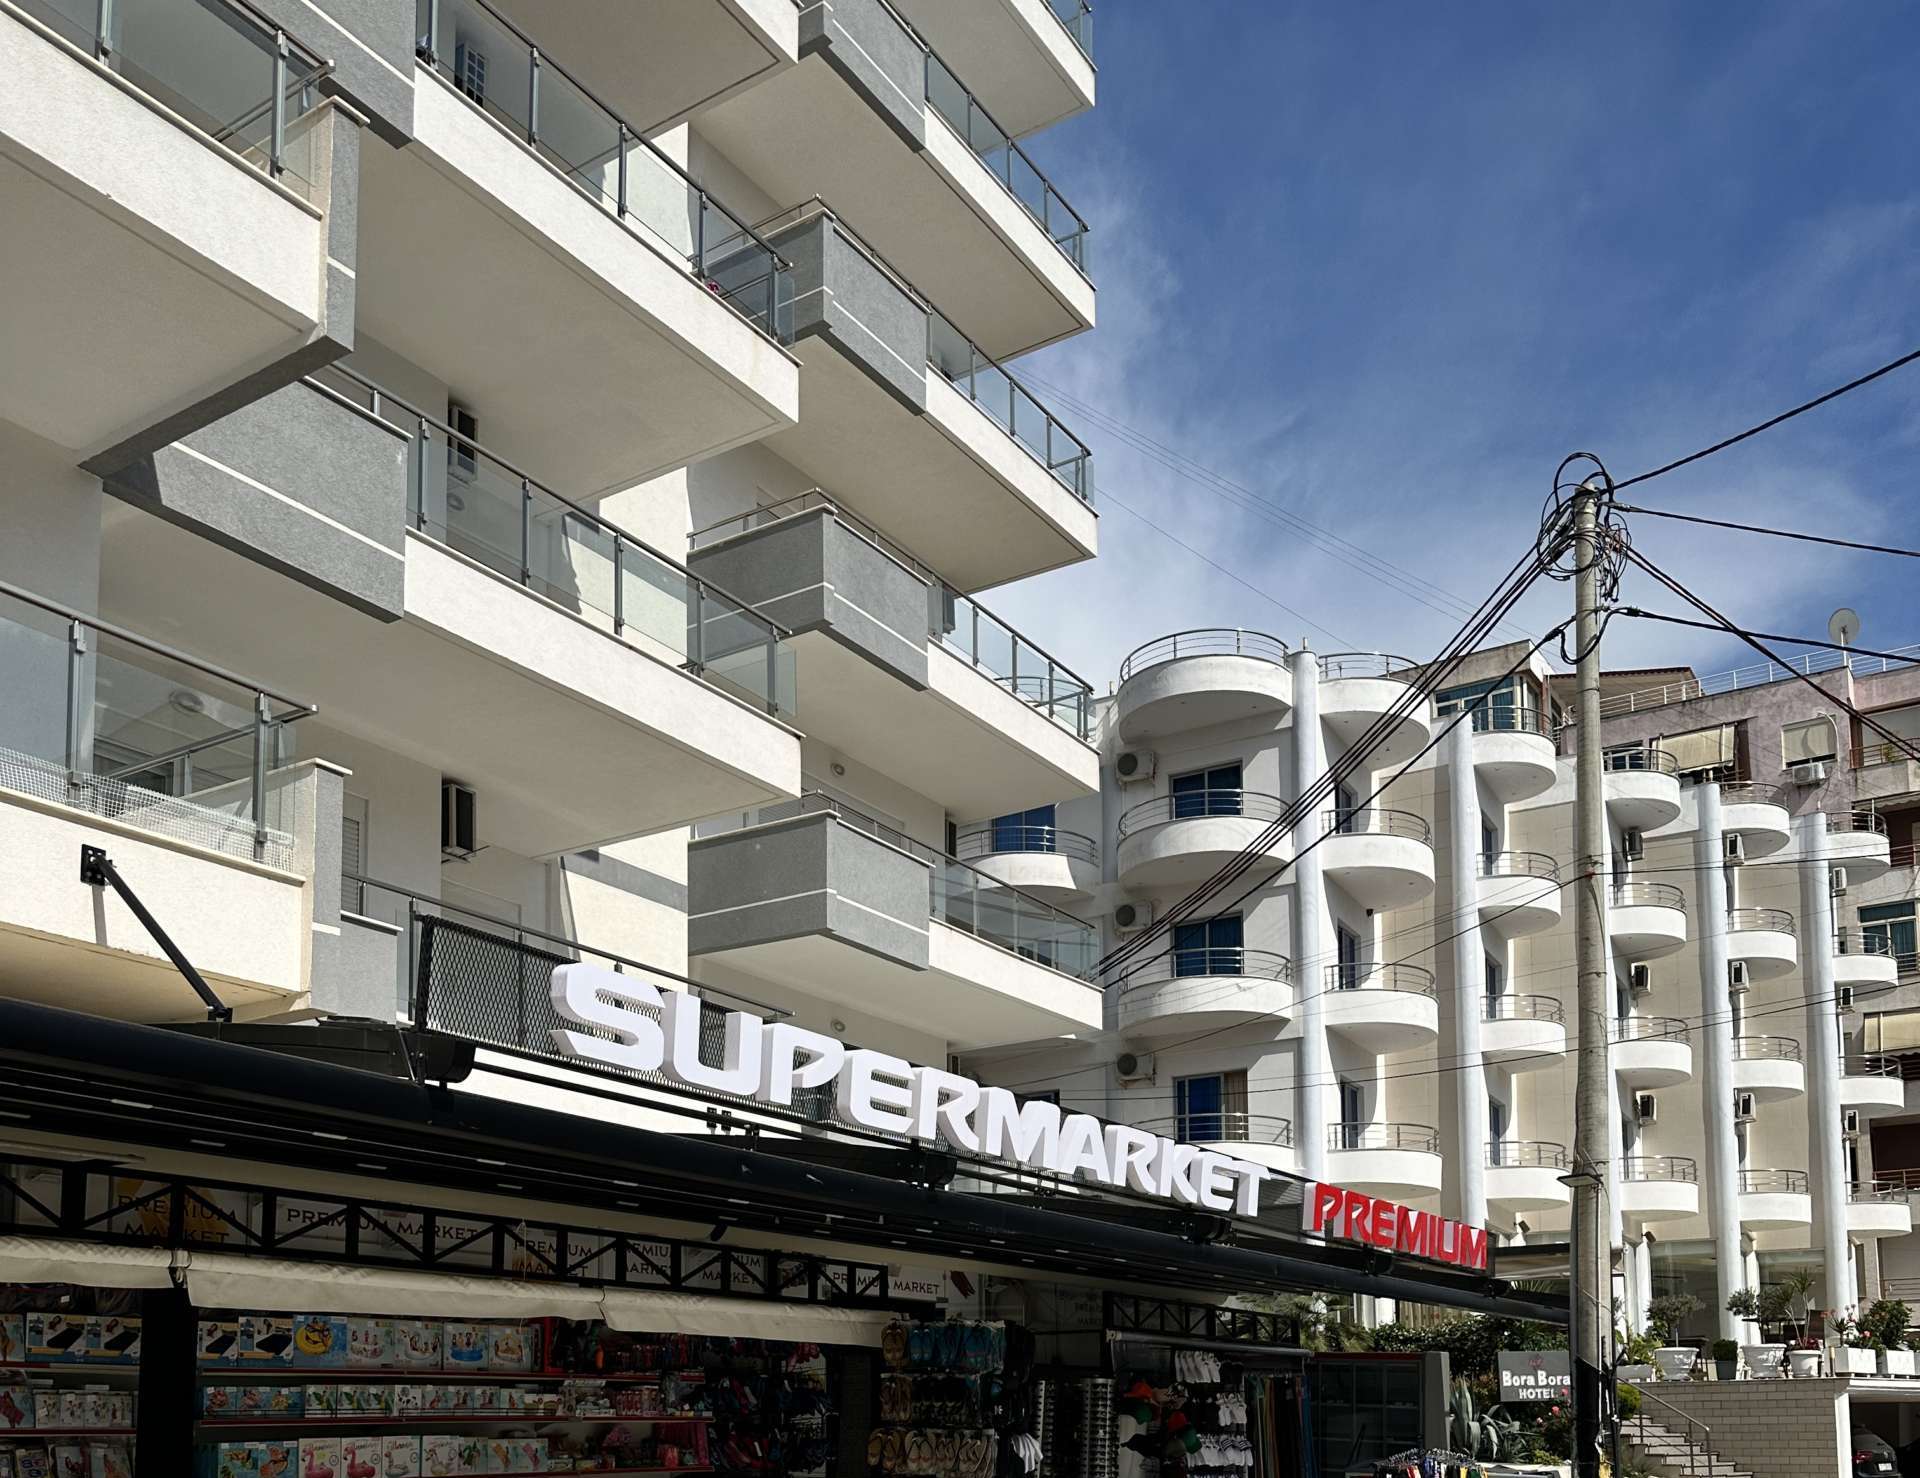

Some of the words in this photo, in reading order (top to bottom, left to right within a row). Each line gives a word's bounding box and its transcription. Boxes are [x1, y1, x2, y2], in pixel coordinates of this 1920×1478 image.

[550, 962, 1271, 1217] SUPERMARKET
[1303, 1182, 1488, 1270] PREMIUM
[893, 1279, 940, 1294] MARKET
[1502, 1369, 1536, 1387] Bora
[1537, 1369, 1571, 1386] Bora
[1519, 1388, 1557, 1399] HOTEL
